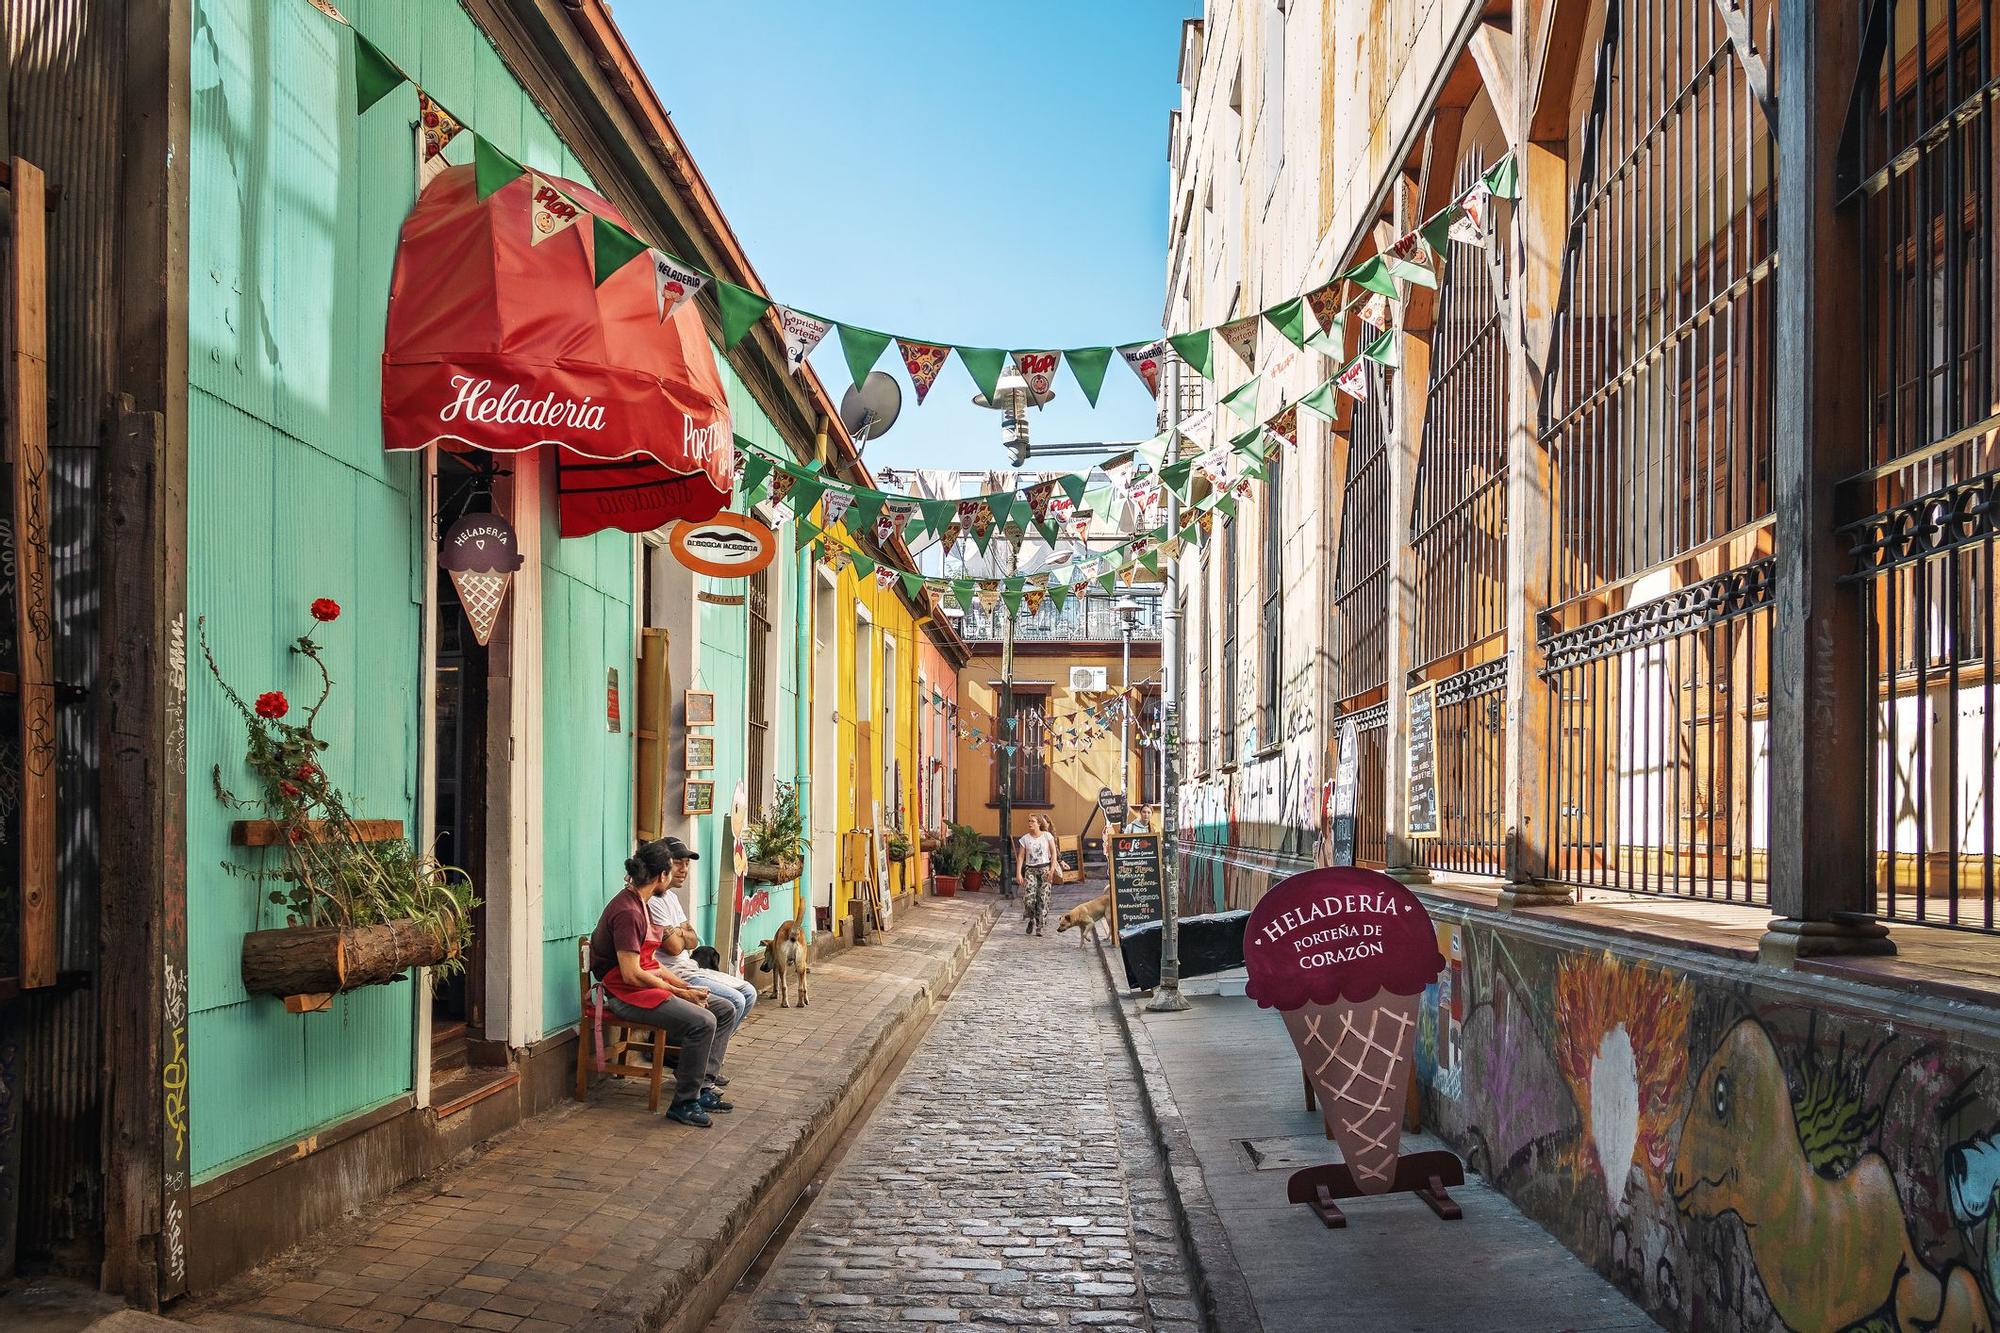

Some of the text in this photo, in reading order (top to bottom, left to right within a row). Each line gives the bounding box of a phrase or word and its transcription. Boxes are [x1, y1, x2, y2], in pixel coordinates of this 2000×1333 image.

[783, 320, 820, 342] Porteño
[784, 310, 824, 333] Capricho
[439, 374, 606, 431] Heladería
[454, 526, 508, 547] HELADERÍA
[1118, 839, 1140, 852] Café
[1262, 891, 1398, 943] HELADERÍA
[1293, 924, 1383, 952] PORTEÑA DE
[1299, 941, 1384, 969] CORAZÓN
